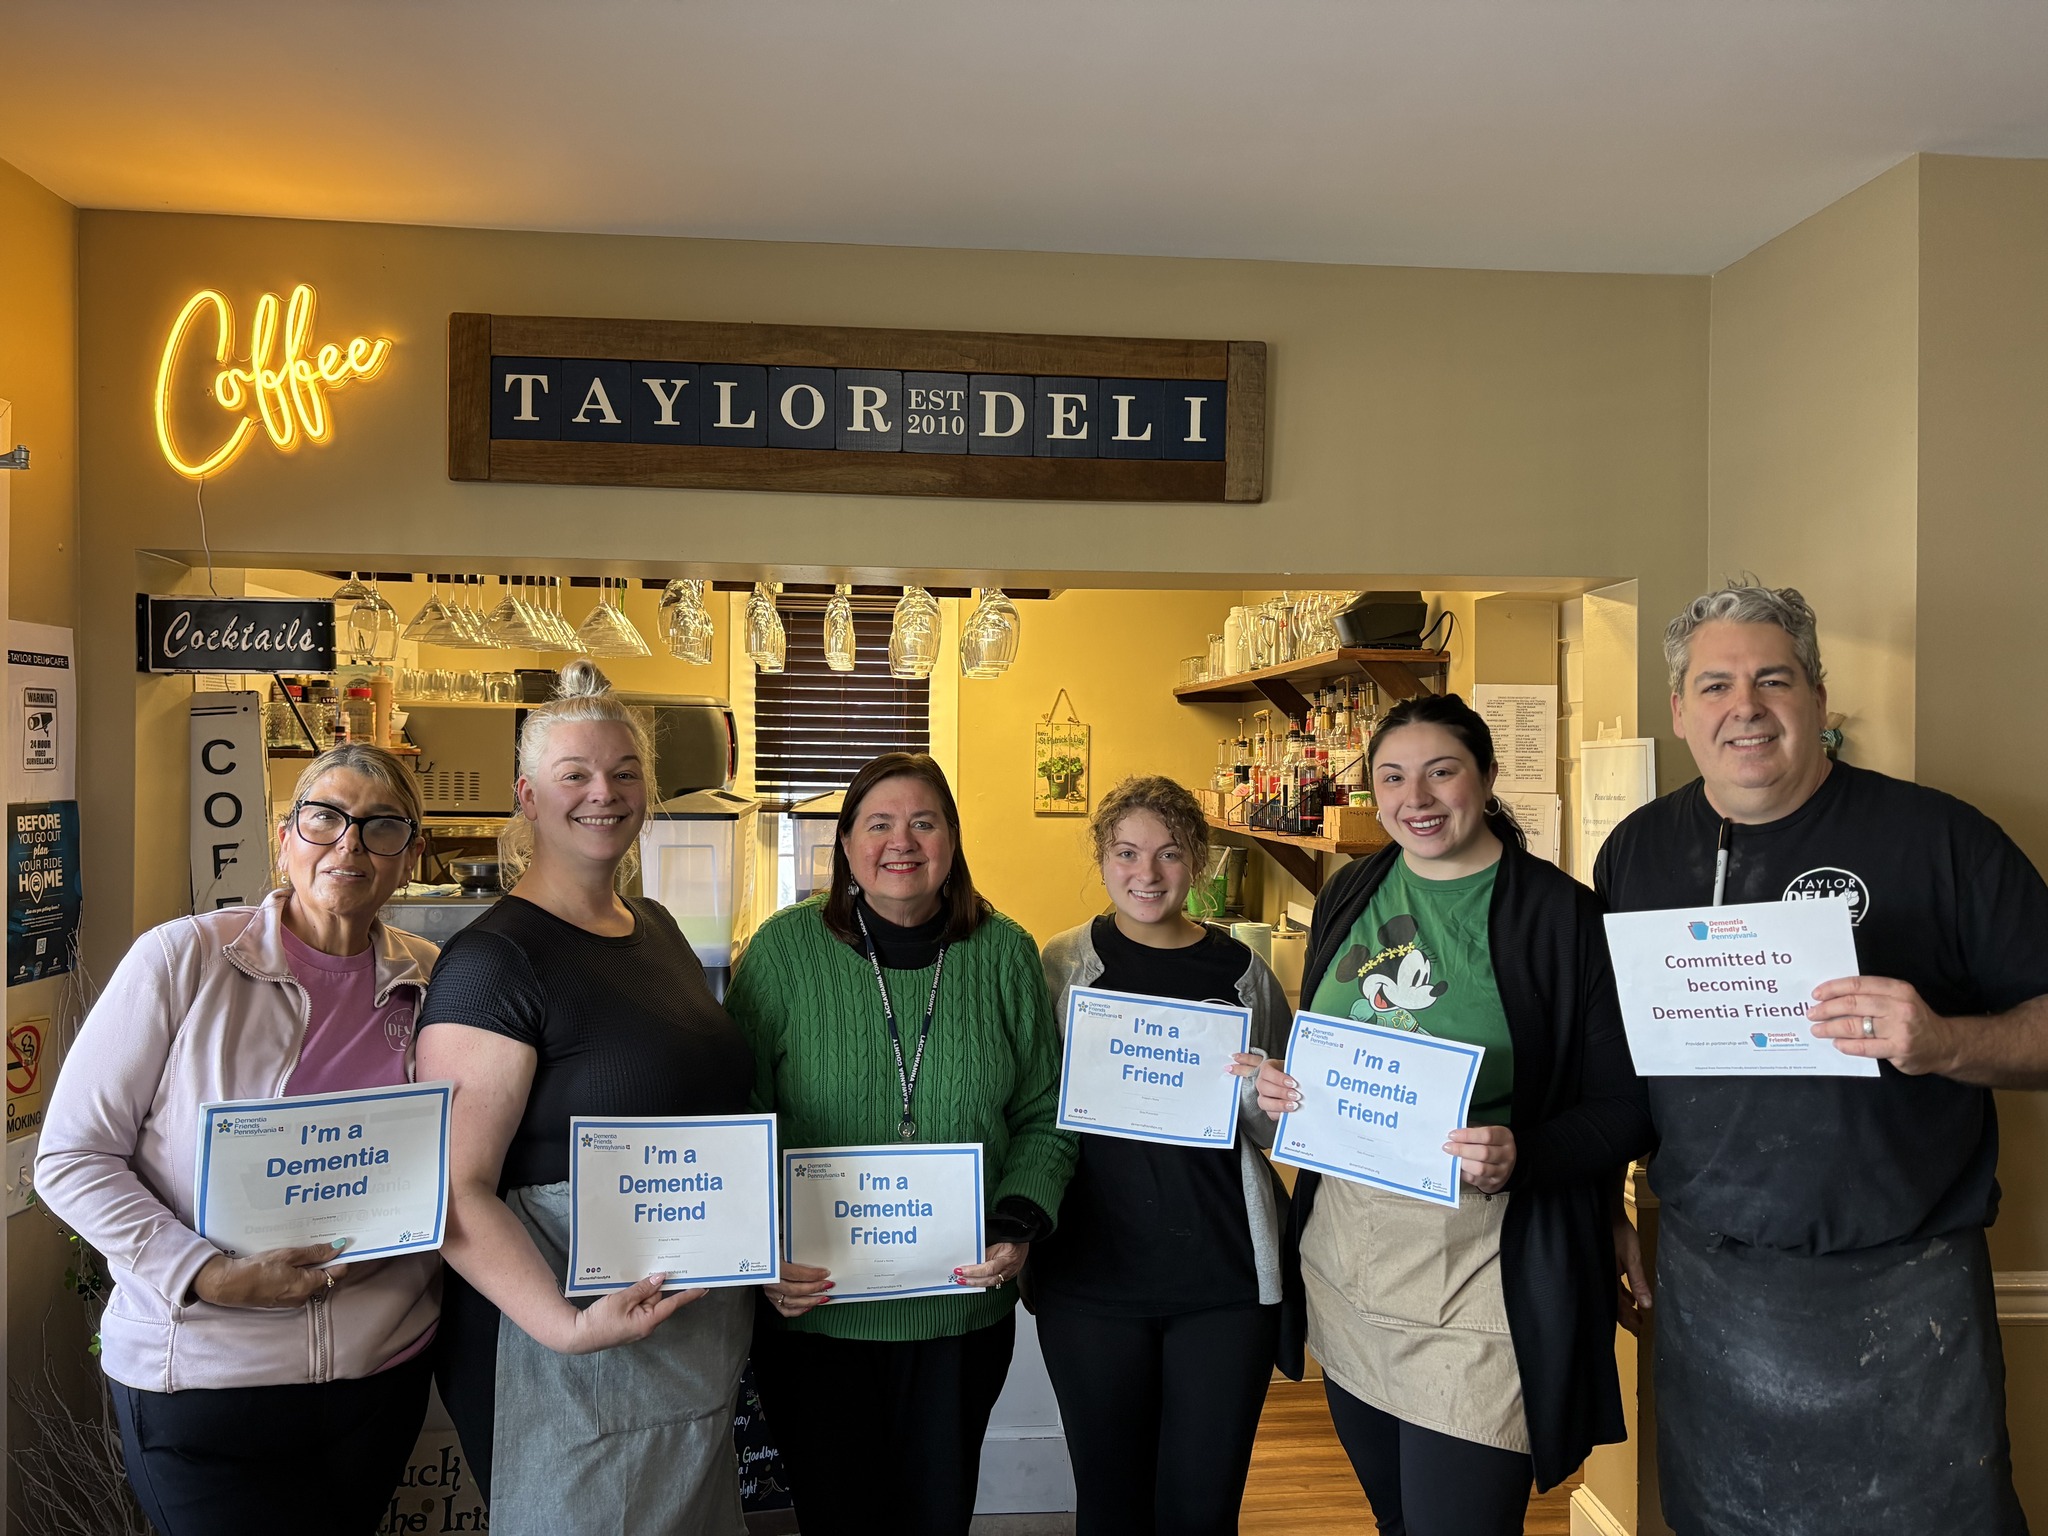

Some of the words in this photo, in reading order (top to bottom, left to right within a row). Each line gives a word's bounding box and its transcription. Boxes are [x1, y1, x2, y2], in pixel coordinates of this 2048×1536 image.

[155, 284, 391, 477] Coffee
[504, 373, 892, 433] TAYLOR
[977, 389, 1207, 443] DELI
[908, 388, 964, 411] EST
[907, 413, 966, 437] 2010
[27, 692, 54, 704] WARNING
[30, 740, 36, 749] 24
[37, 740, 51, 749] HOUR
[26, 757, 54, 765] SURVEILLANCE
[17, 813, 62, 832] BEFORE
[18, 832, 34, 845] YOU
[34, 831, 46, 844] GO
[47, 830, 62, 843] OUT
[33, 843, 50, 860] plan
[18, 859, 42, 872] YOUR
[43, 856, 63, 869] RIDE
[1798, 878, 1856, 889] TAYLOR
[1709, 918, 1744, 926] Dementia
[1710, 926, 1740, 934] Friendly
[1711, 931, 1758, 940] Pennsylvania
[869, 951, 881, 975] COUNTY
[932, 948, 945, 989] LACKAWANNA
[1665, 950, 1767, 970] Committed
[1771, 949, 1793, 966] to
[877, 974, 893, 1019] LACKAWANNA
[1686, 976, 1779, 995] becoming
[926, 989, 937, 1016] COUNTY
[1652, 1003, 1740, 1021] Dementia
[1744, 1001, 1809, 1019] Friendl
[1133, 1017, 1163, 1037] I'm
[1168, 1026, 1180, 1039] a
[892, 1038, 903, 1067] COUNTY
[909, 1034, 926, 1082] LACKAWANNA
[1109, 1038, 1201, 1066] Dementia
[1352, 1047, 1384, 1071] I'm
[1387, 1059, 1401, 1074] a
[1122, 1063, 1184, 1088] Friend
[1326, 1068, 1418, 1106] Dementia
[7, 1102, 16, 1118] O
[1337, 1098, 1399, 1130] Friend
[7, 1110, 42, 1134] MOKING
[233, 1127, 277, 1135] Pennsylvania
[301, 1124, 340, 1145] I'm
[347, 1123, 363, 1140] a
[266, 1146, 390, 1179] Dementia
[644, 1145, 677, 1165] I'm
[683, 1148, 697, 1164] a
[284, 1175, 369, 1206] Friend
[619, 1172, 723, 1194] Dementia
[859, 1172, 890, 1191] I'm
[896, 1175, 909, 1190] a
[634, 1200, 706, 1223] Friend
[834, 1199, 933, 1218] Dementia
[850, 1225, 917, 1245] Friend
[742, 1445, 780, 1464] Goodbye
[397, 1445, 462, 1492] uck
